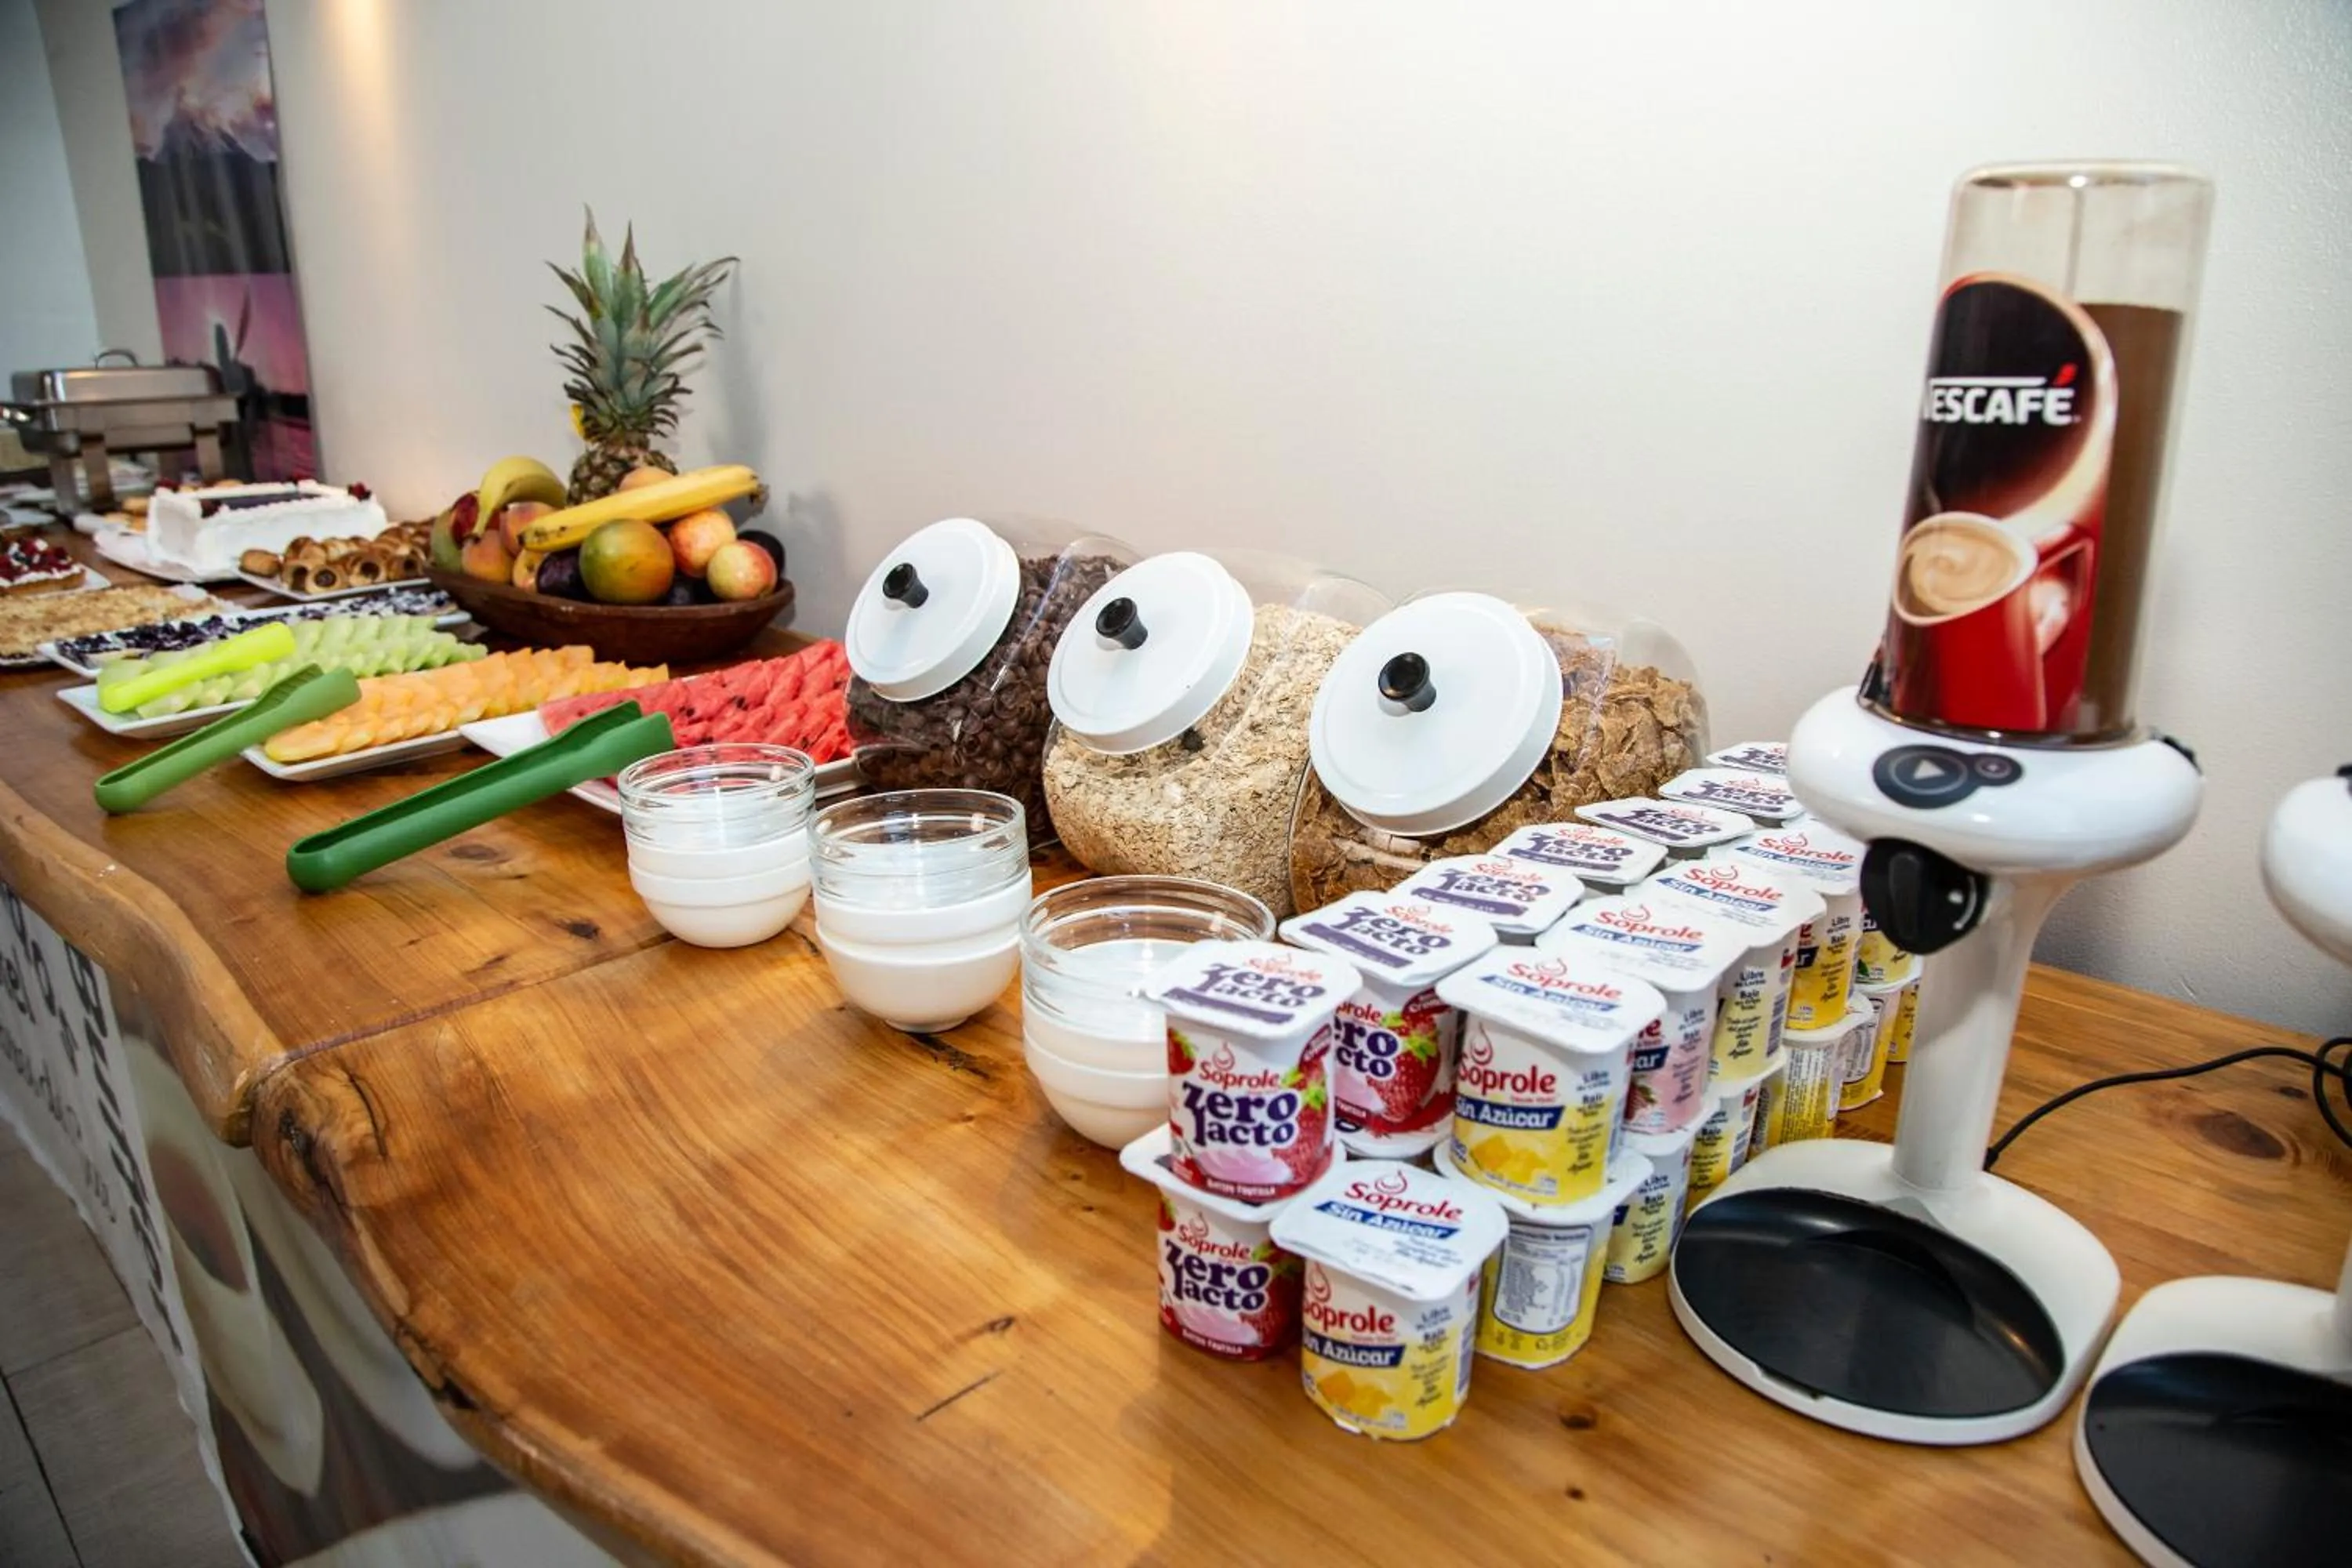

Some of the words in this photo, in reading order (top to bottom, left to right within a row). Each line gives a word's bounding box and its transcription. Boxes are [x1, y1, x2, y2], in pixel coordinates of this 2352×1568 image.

[1758, 838, 1855, 862] Soprole
[1684, 867, 1783, 901] Soprole
[1595, 910, 1704, 939] Soprole
[1200, 963, 1326, 998] zero
[1507, 962, 1622, 1000] Soprole
[1198, 1061, 1280, 1091] Soprole
[1335, 1047, 1393, 1078] cto
[1181, 1080, 1299, 1124] zero
[1192, 1105, 1295, 1148] lacto
[1328, 1201, 1363, 1223] Sin
[1344, 1181, 1463, 1220] Soprole
[1178, 1224, 1251, 1260] Soprole
[1165, 1238, 1270, 1291] zero
[1173, 1264, 1266, 1312] lacto
